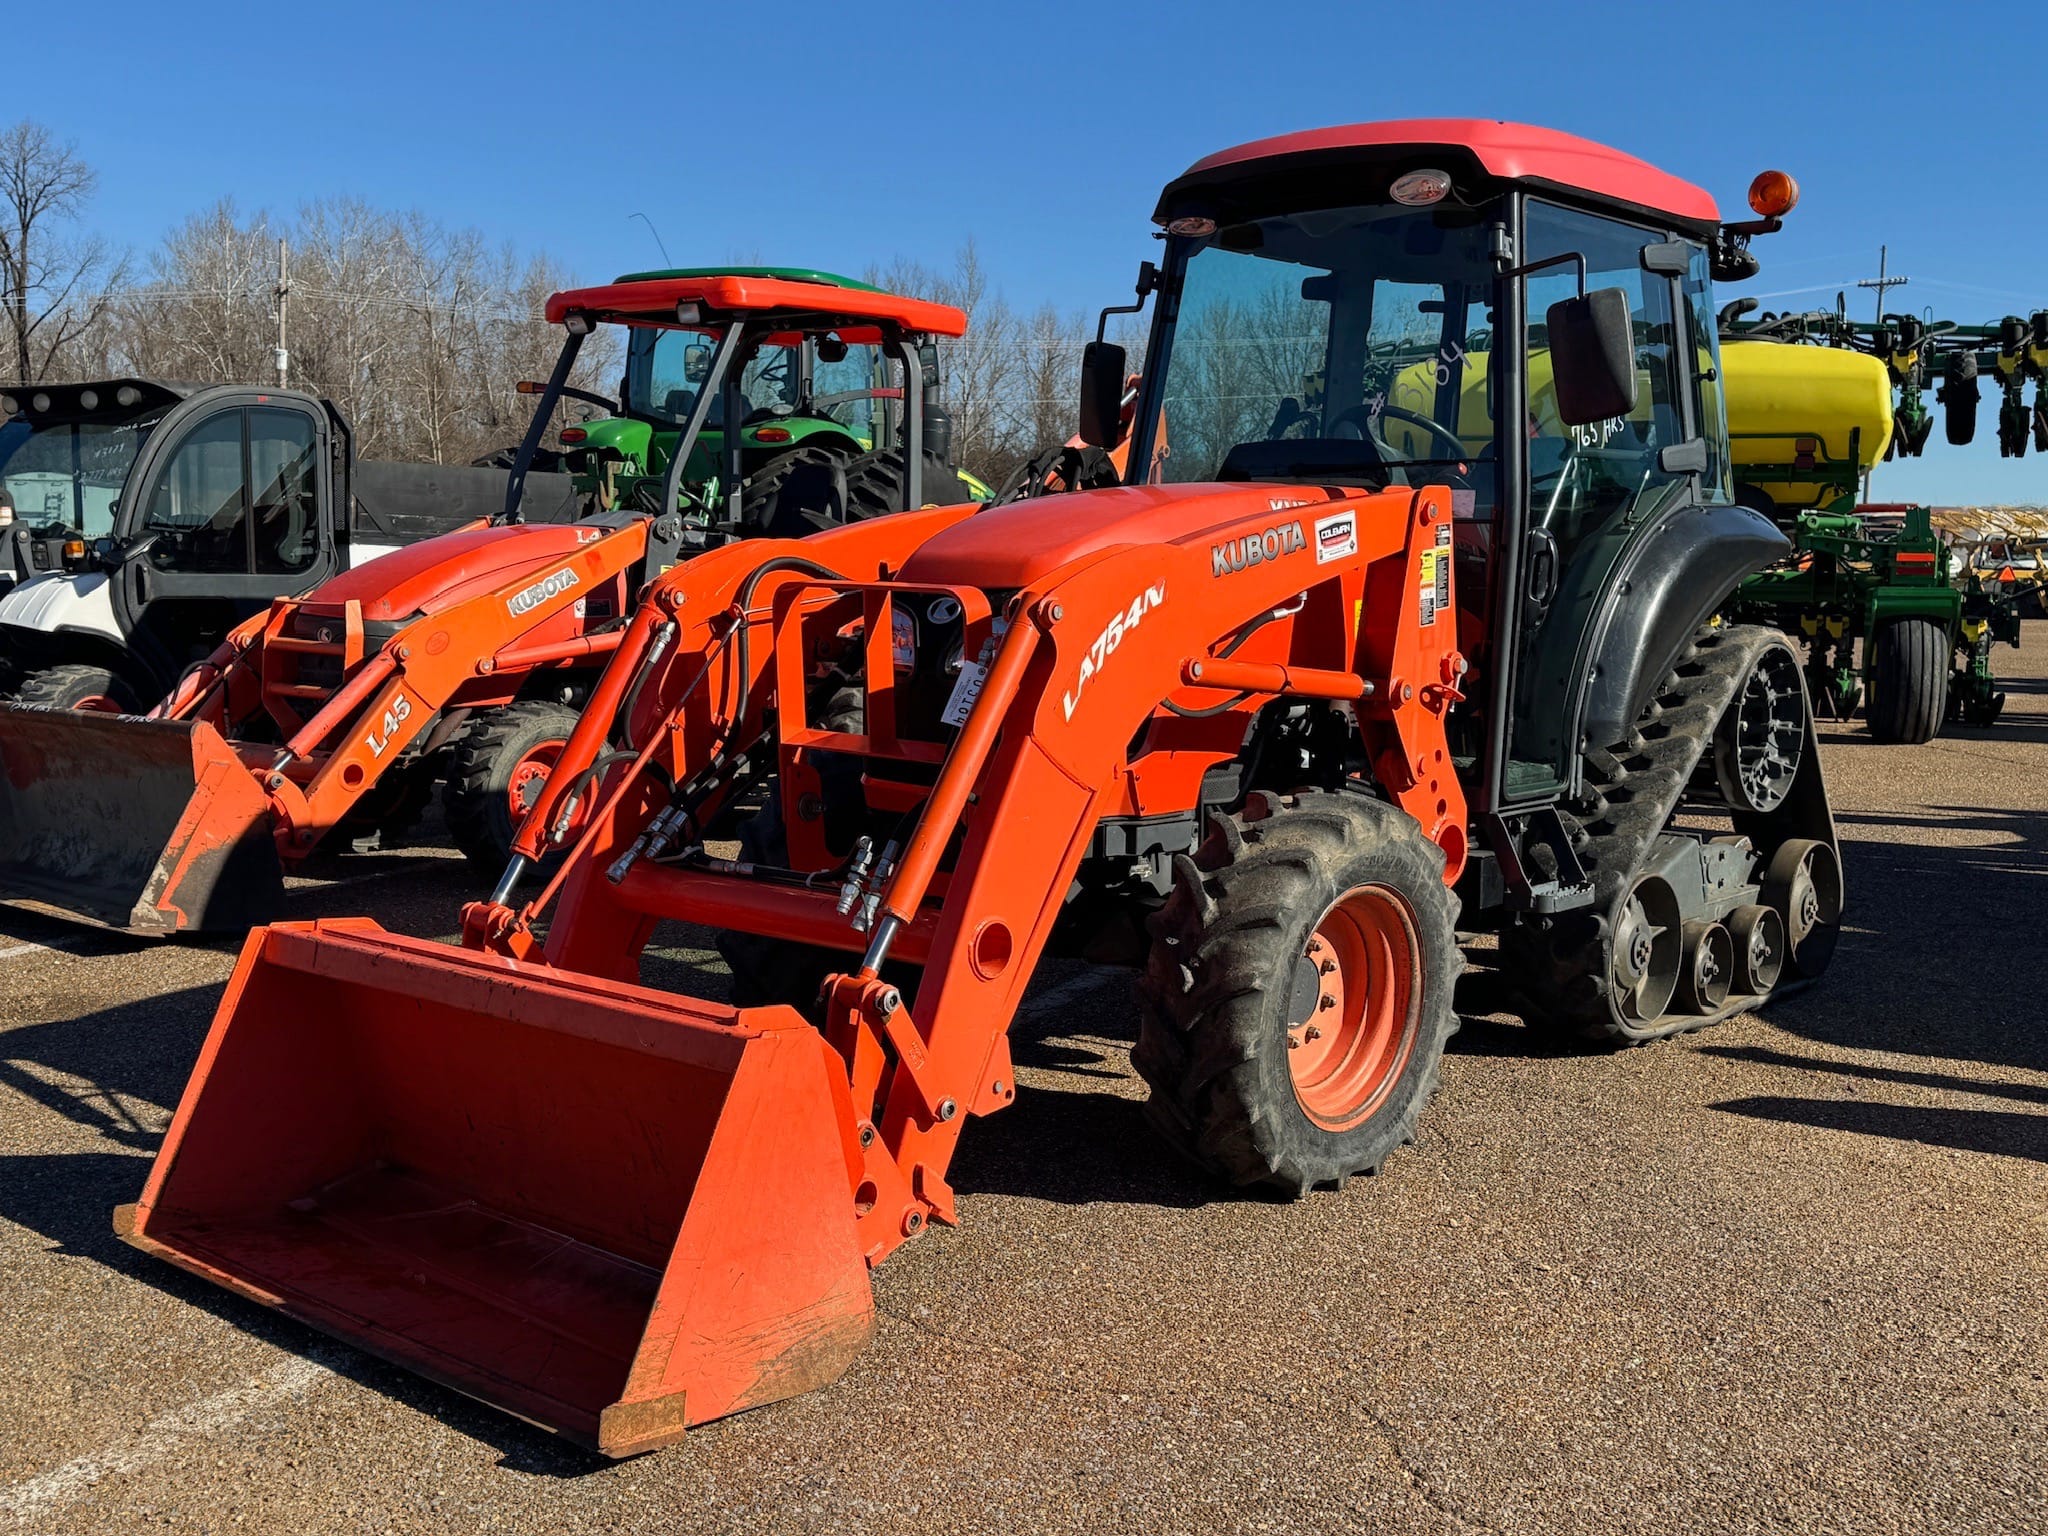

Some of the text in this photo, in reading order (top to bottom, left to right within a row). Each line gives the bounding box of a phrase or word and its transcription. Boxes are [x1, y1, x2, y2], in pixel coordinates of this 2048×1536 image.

[1571, 415, 1625, 453] 765 HRS
[1211, 520, 1307, 578] KUBOTA
[507, 567, 580, 617] KUBOTA
[1062, 579, 1167, 723] LA754N
[365, 692, 412, 759] L45
